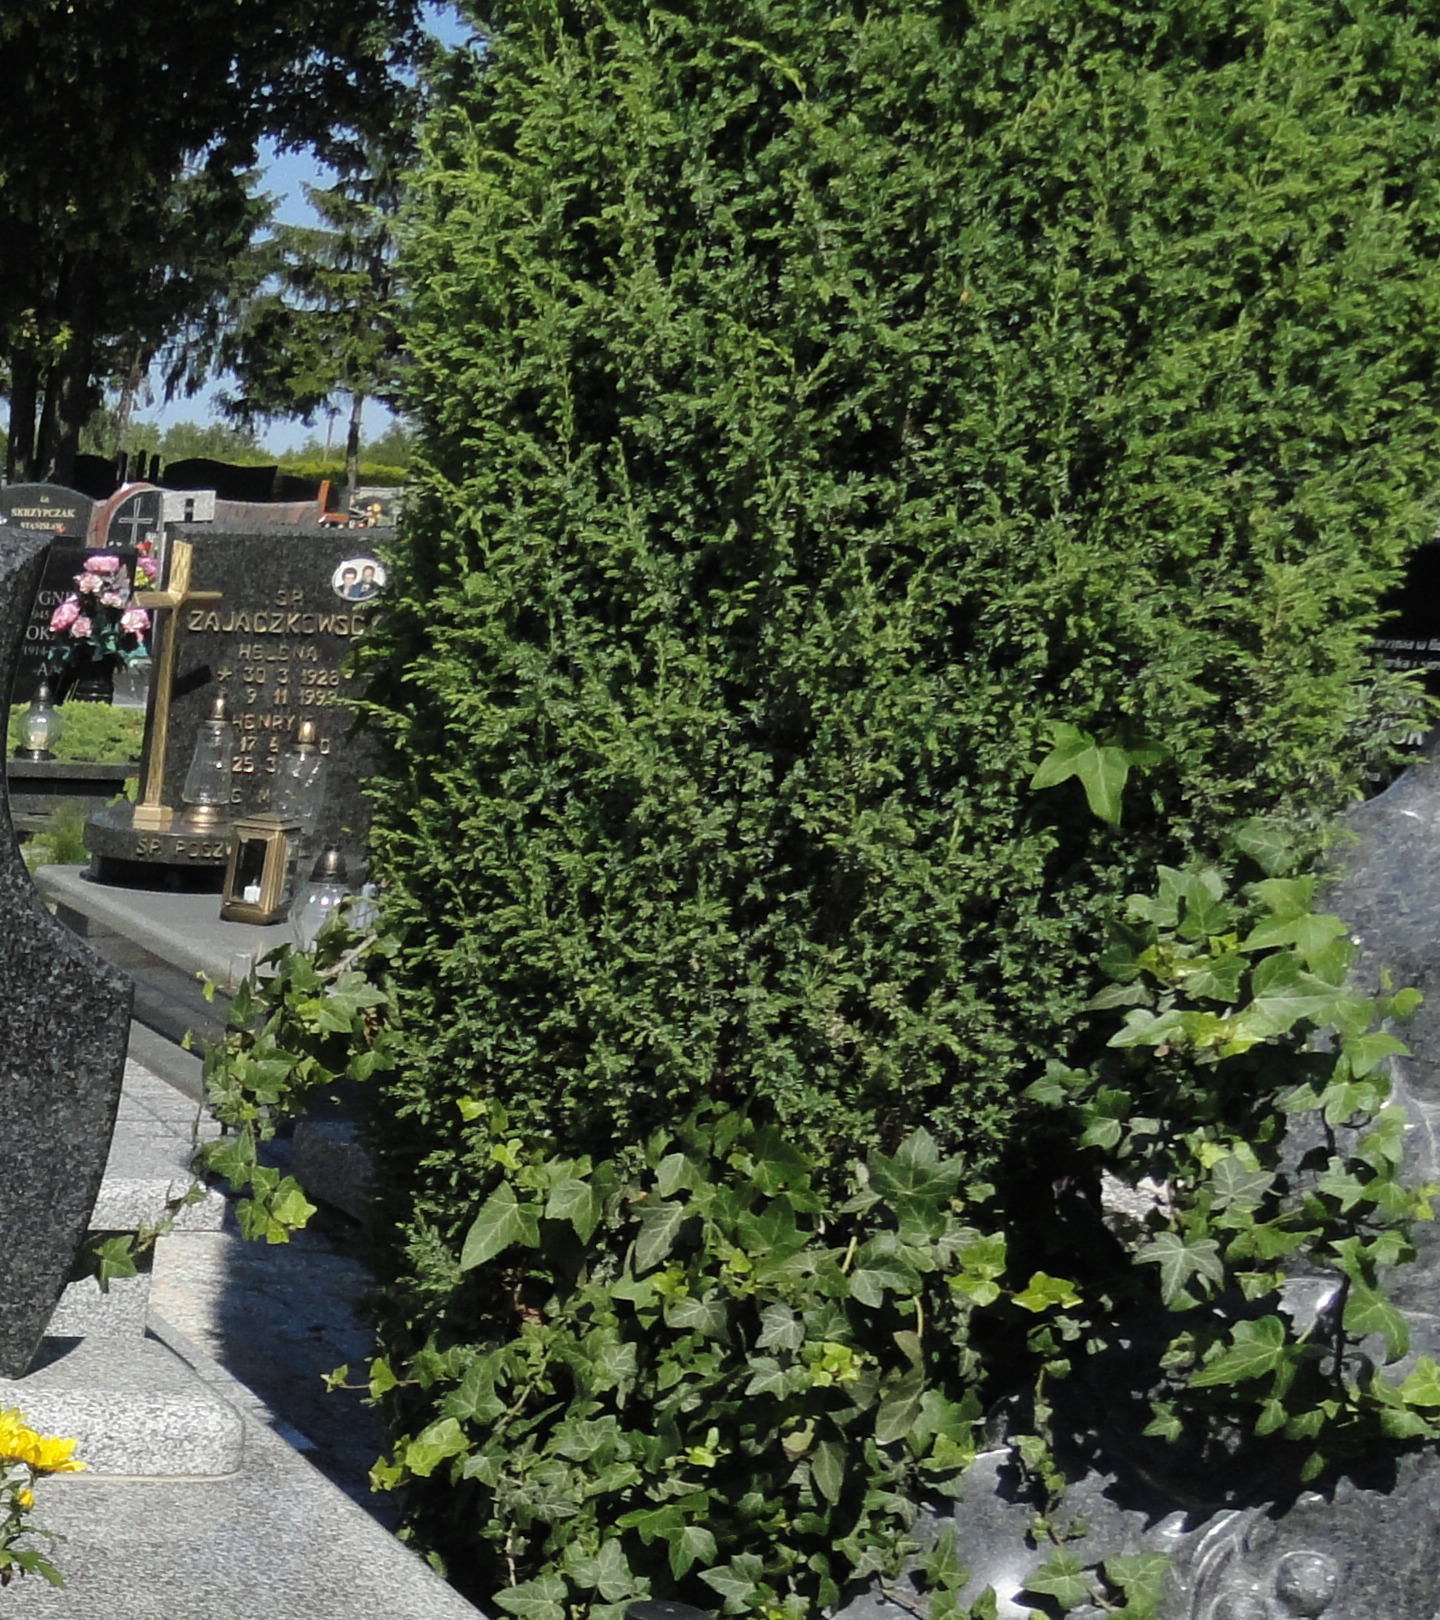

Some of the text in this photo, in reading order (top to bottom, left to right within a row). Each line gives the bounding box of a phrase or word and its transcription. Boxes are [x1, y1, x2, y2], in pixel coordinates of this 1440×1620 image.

[237, 643, 319, 663] HELENA
[243, 667, 266, 684] 30
[277, 668, 289, 685] 3
[232, 712, 314, 731] HENRY
[231, 757, 255, 773] 25
